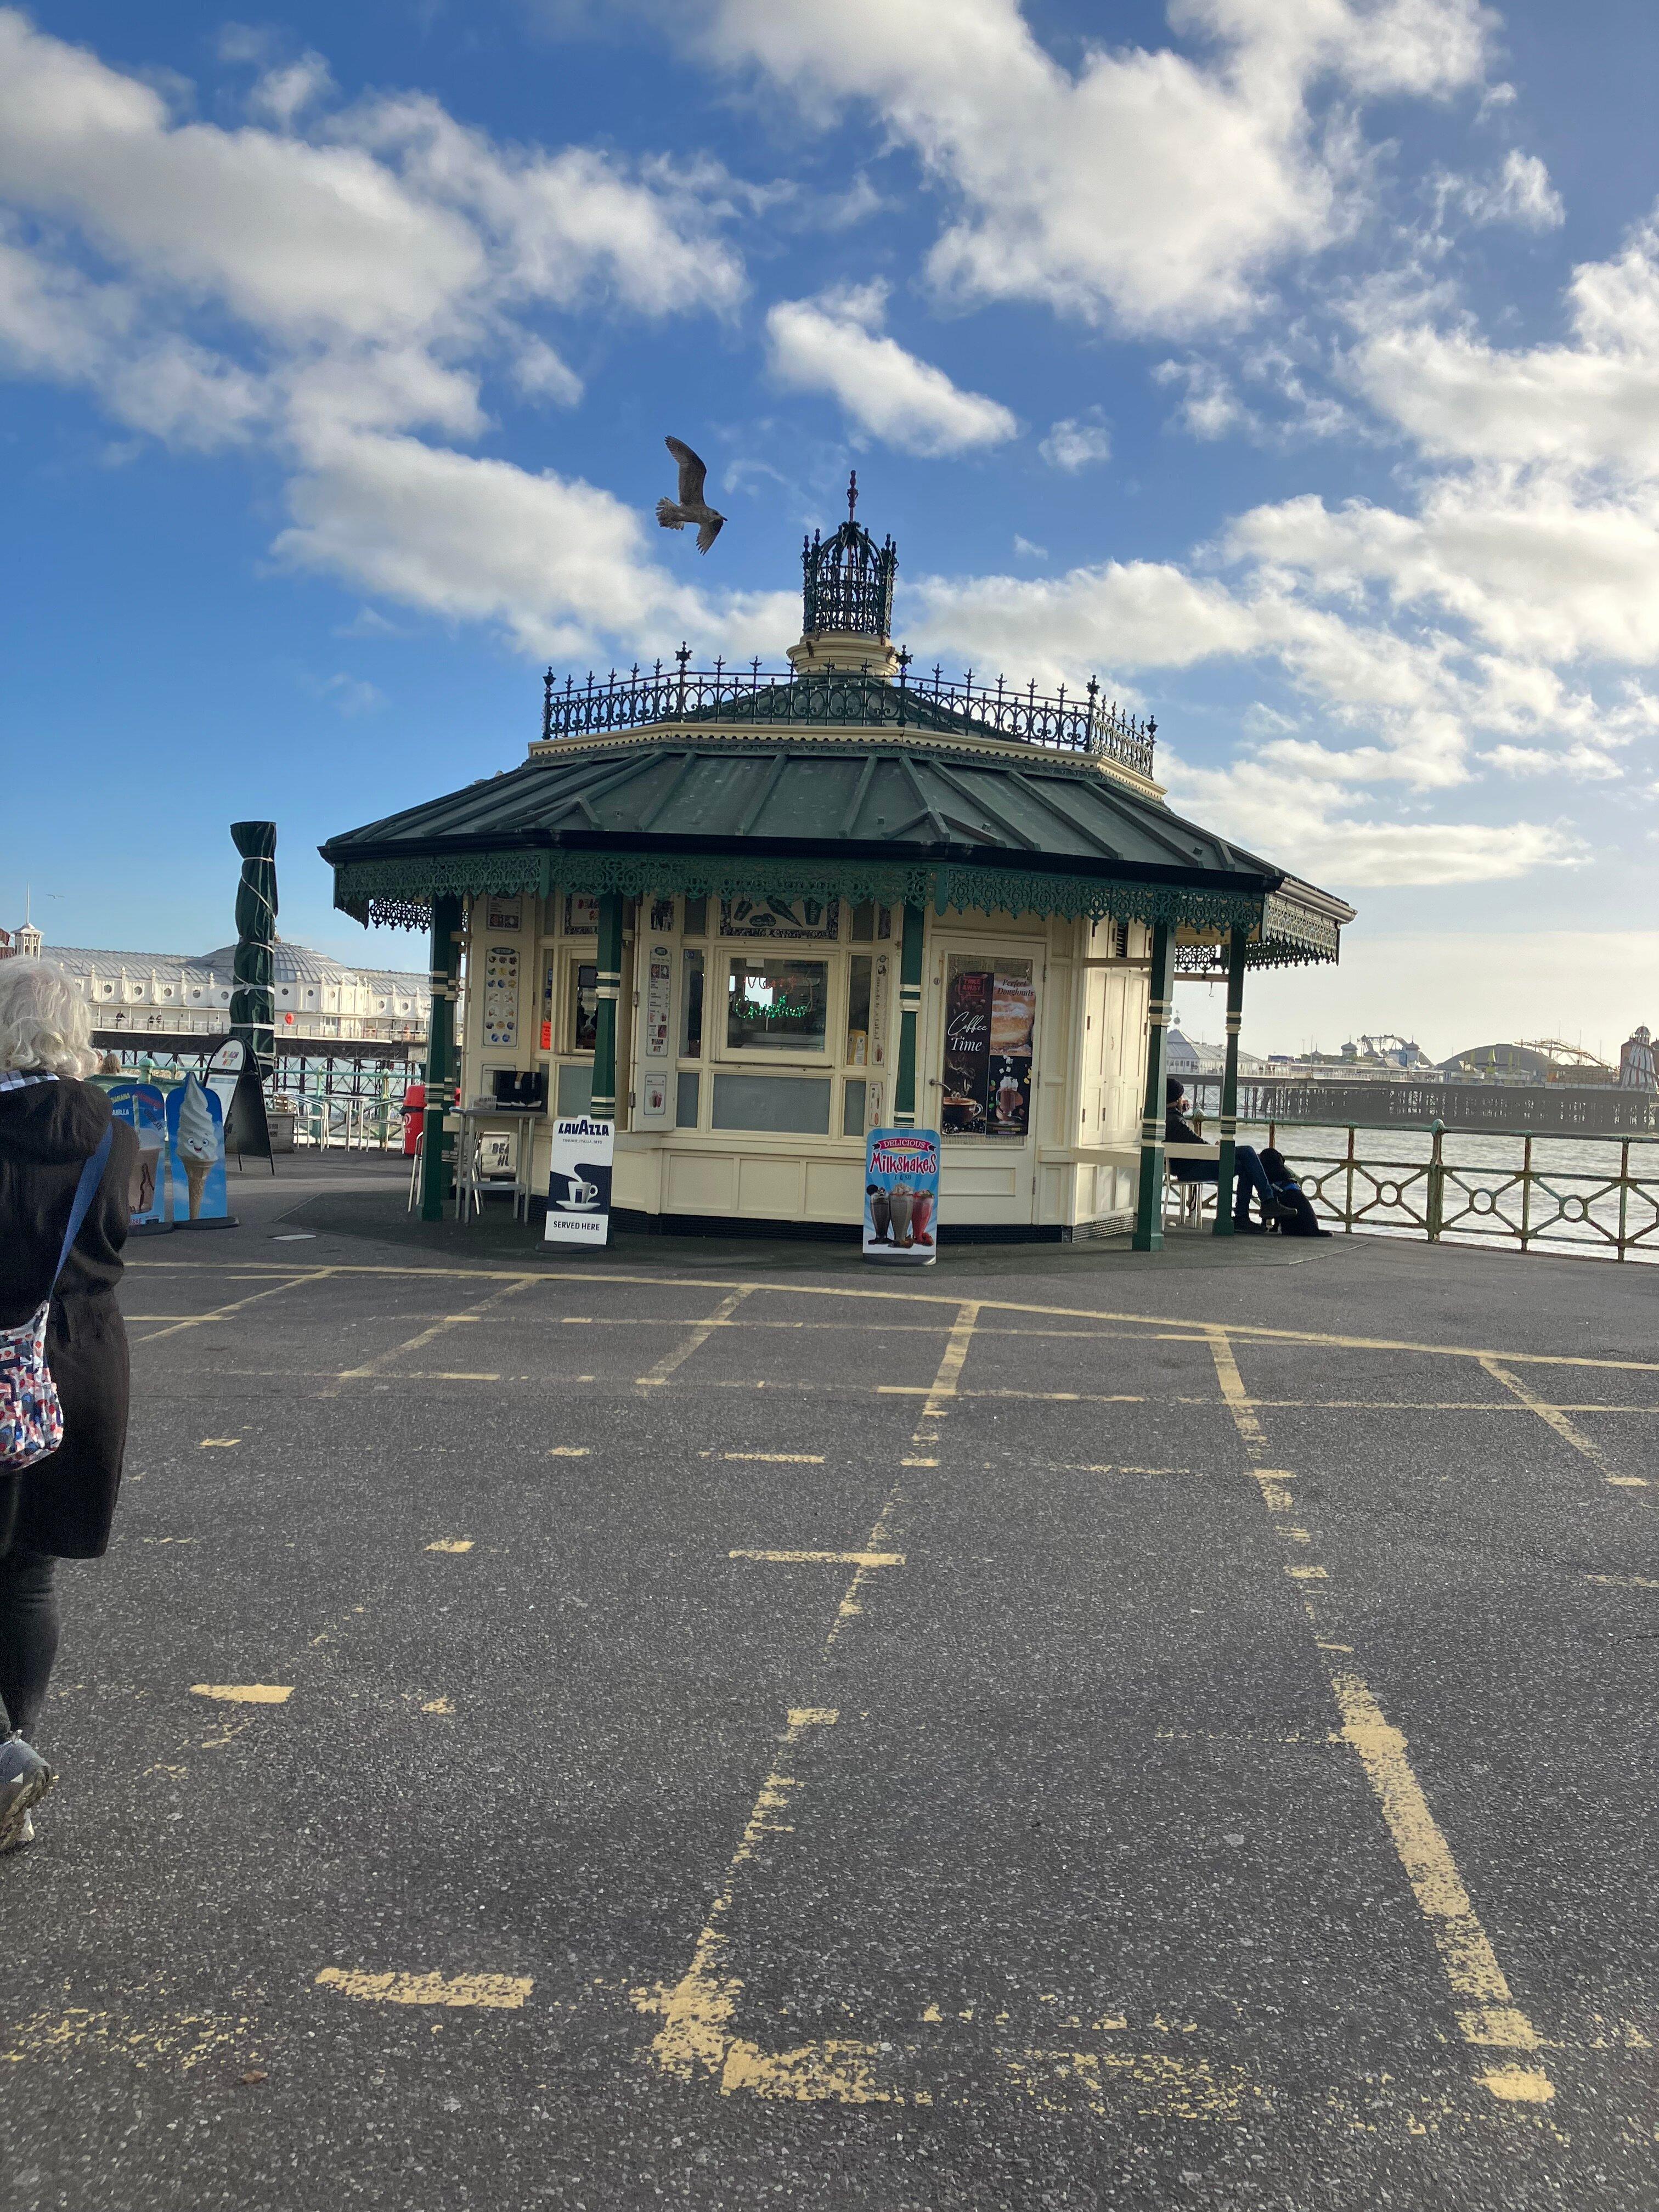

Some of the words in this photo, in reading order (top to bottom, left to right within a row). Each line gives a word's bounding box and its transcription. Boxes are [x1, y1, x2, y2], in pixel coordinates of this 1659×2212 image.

[1003, 979, 1029, 988] Perfect
[997, 988, 1034, 997] Doughnuts
[947, 1011, 988, 1036] Coffee
[951, 1036, 983, 1052] Time
[558, 1119, 610, 1136] LAVAZZA
[883, 1139, 926, 1149] DELICIOUS
[553, 1221, 580, 1229] SERVED
[582, 1223, 600, 1231] HERE
